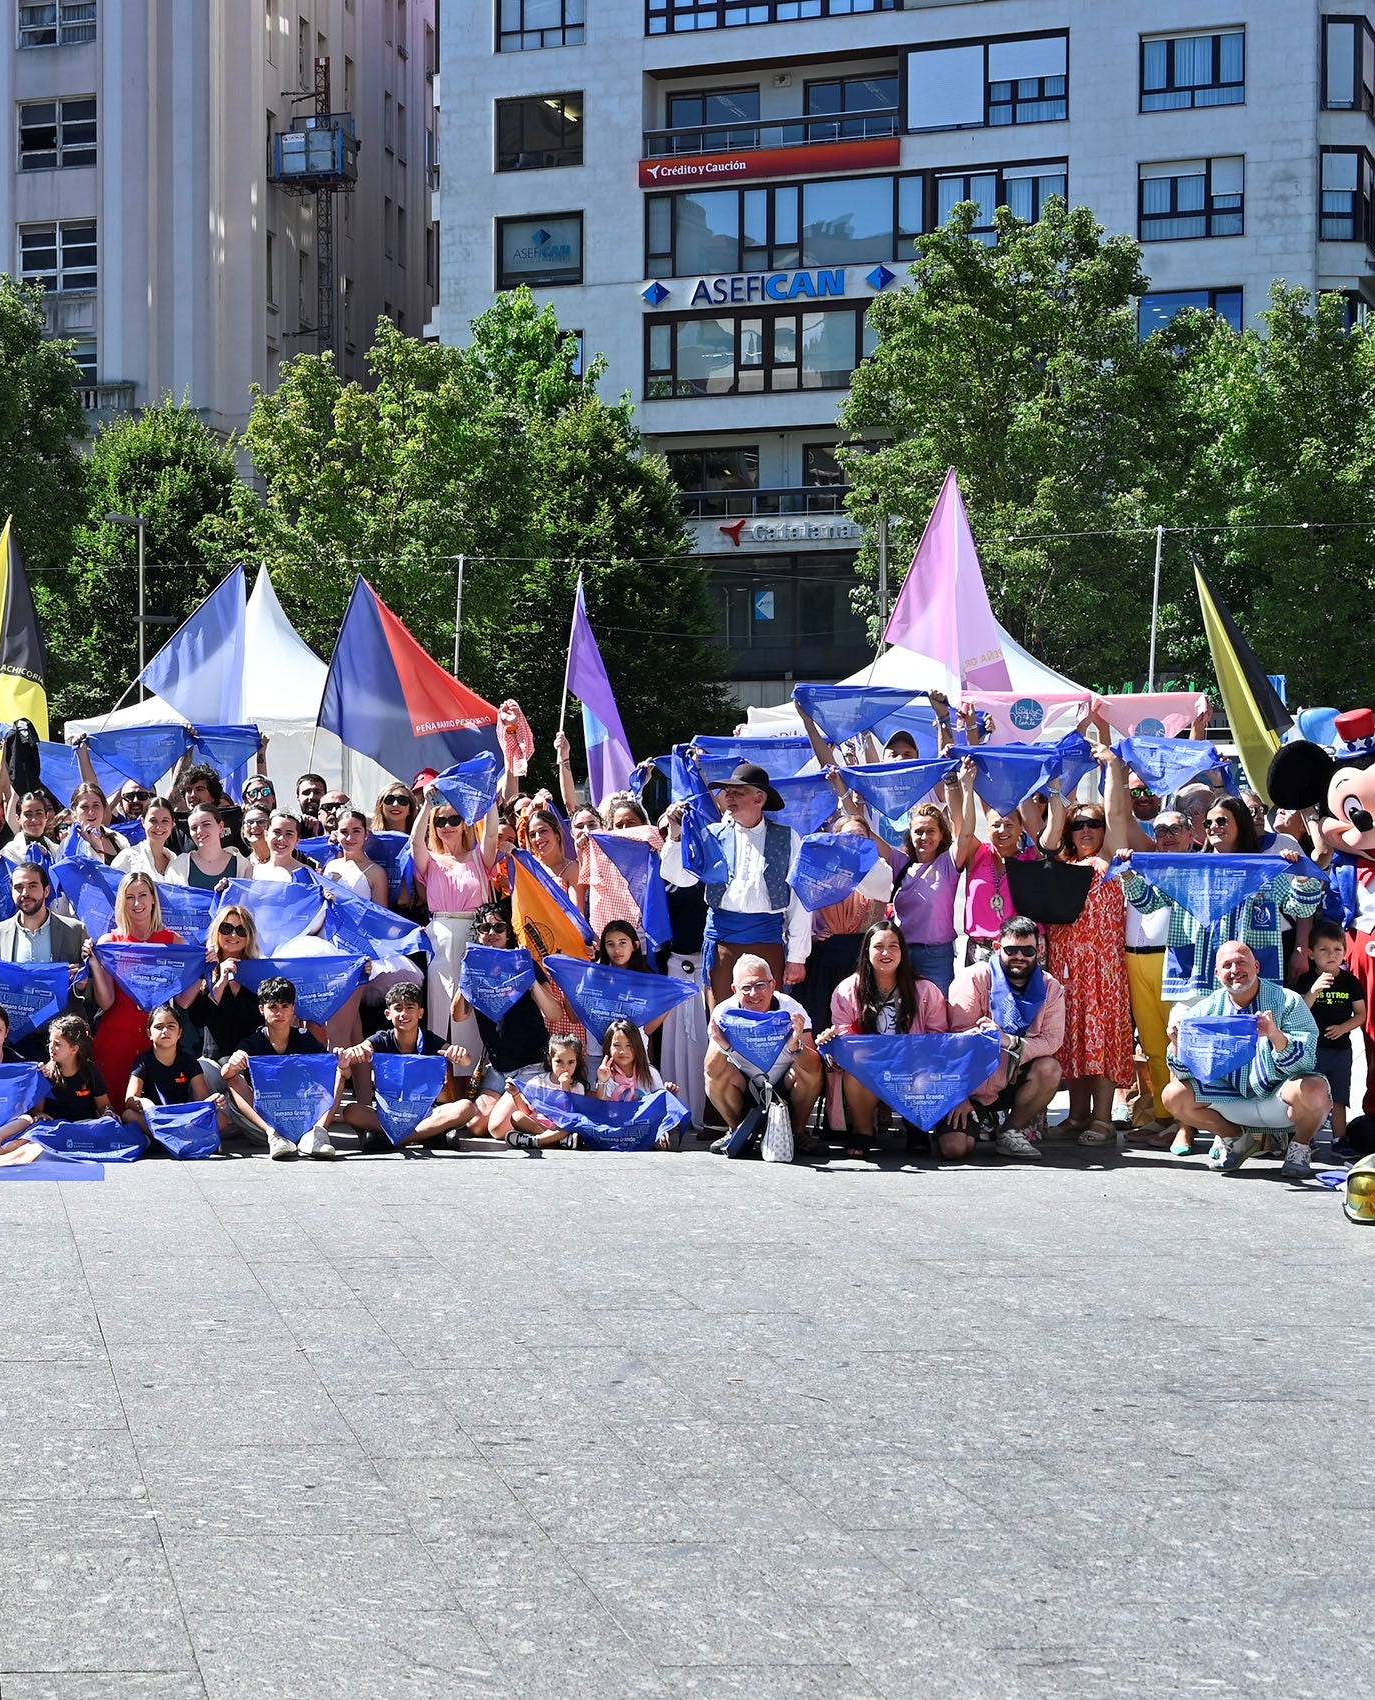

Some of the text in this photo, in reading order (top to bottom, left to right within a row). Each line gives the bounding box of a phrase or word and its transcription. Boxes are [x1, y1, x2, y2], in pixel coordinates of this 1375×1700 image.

[661, 160, 747, 176] Crédito y Caución
[513, 245, 571, 260] ASEFICAN
[691, 269, 845, 306] ASEFICAN
[752, 521, 852, 542] Catalana
[416, 722, 436, 733] PEÑA
[591, 1008, 628, 1019] Semana Grande
